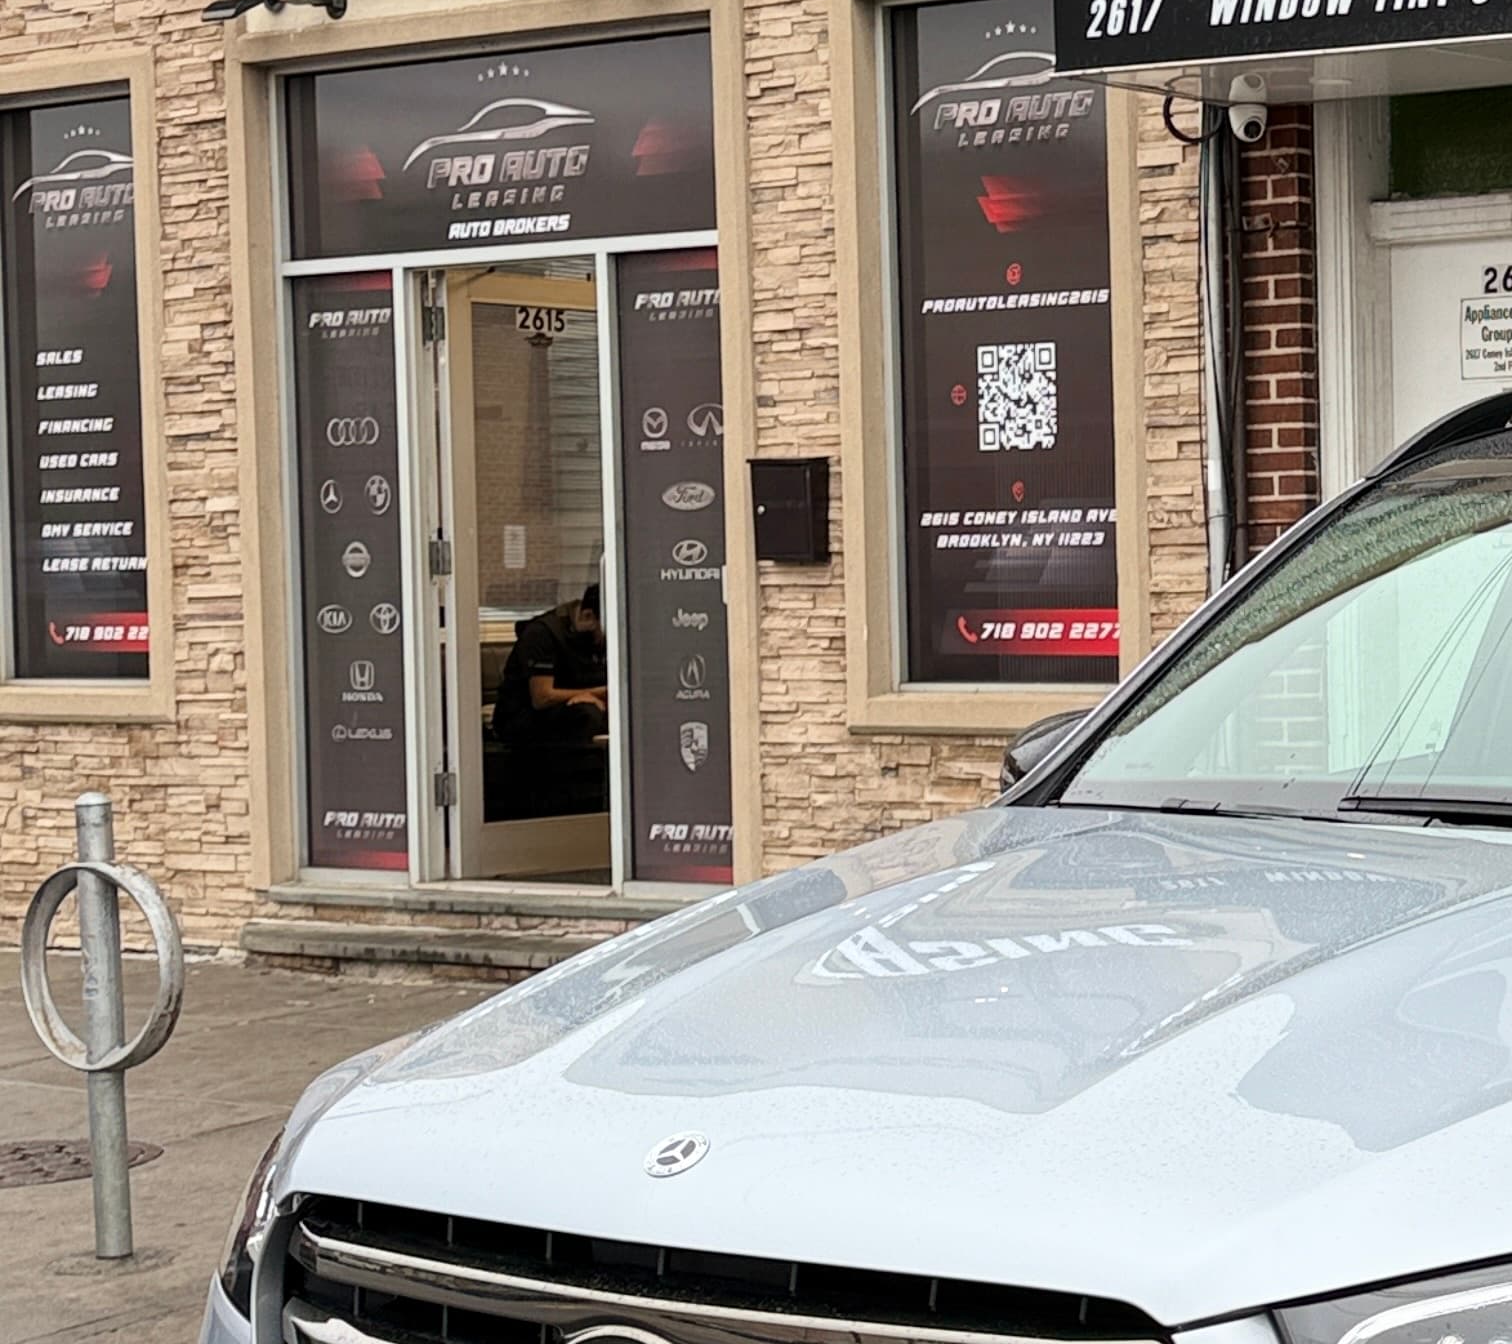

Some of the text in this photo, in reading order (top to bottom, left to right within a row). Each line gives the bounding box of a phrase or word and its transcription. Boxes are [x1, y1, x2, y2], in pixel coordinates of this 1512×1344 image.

[934, 89, 1094, 130] PRO AUTO
[958, 123, 1070, 147] LEASING
[427, 145, 590, 189] PRO AUTO
[28, 189, 76, 214] PRO
[452, 184, 565, 210] LEASING
[448, 213, 571, 240] AUTO BROKERS
[634, 292, 675, 310] PRO
[309, 308, 392, 328] PRO AUTO
[518, 308, 566, 332] 2615
[1481, 325, 1512, 343] Group
[36, 349, 82, 366] SALES
[37, 383, 98, 401] LEASING
[38, 418, 114, 435] FINANCING
[40, 452, 118, 470] USED CARS
[40, 486, 120, 504] INSURANCE
[920, 512, 960, 527] 2615
[963, 510, 1018, 526] CONEY
[1020, 509, 1083, 524] ISLAND
[73, 521, 133, 537] SERVICE
[1032, 533, 1054, 546] NY
[1058, 531, 1105, 546] 11223
[43, 557, 89, 572] LEASE
[65, 625, 90, 641] 718
[980, 623, 1016, 640] 718
[1020, 623, 1064, 639] 902
[324, 811, 406, 829] PRO AUTO
[649, 824, 688, 840] PRO
